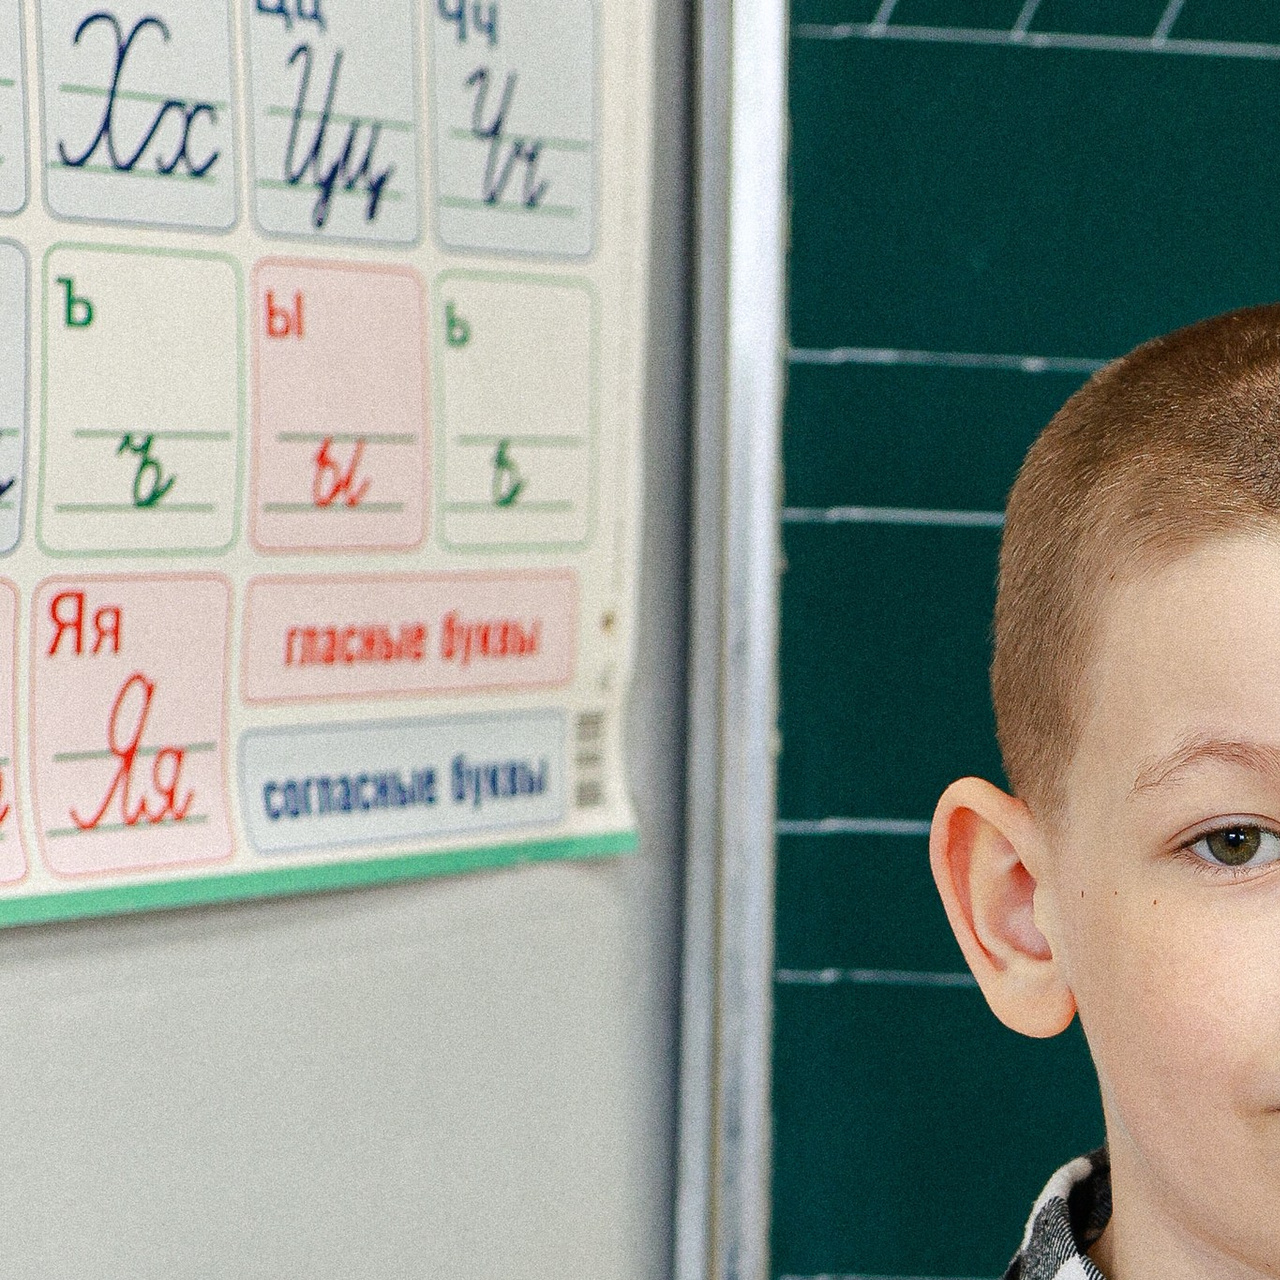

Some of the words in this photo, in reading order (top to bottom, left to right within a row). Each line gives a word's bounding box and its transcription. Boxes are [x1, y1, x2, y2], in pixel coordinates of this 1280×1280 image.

[283, 621, 426, 669] гласные
[439, 608, 544, 669] буквы
[263, 765, 437, 820] согласные
[450, 753, 548, 811] буквы
